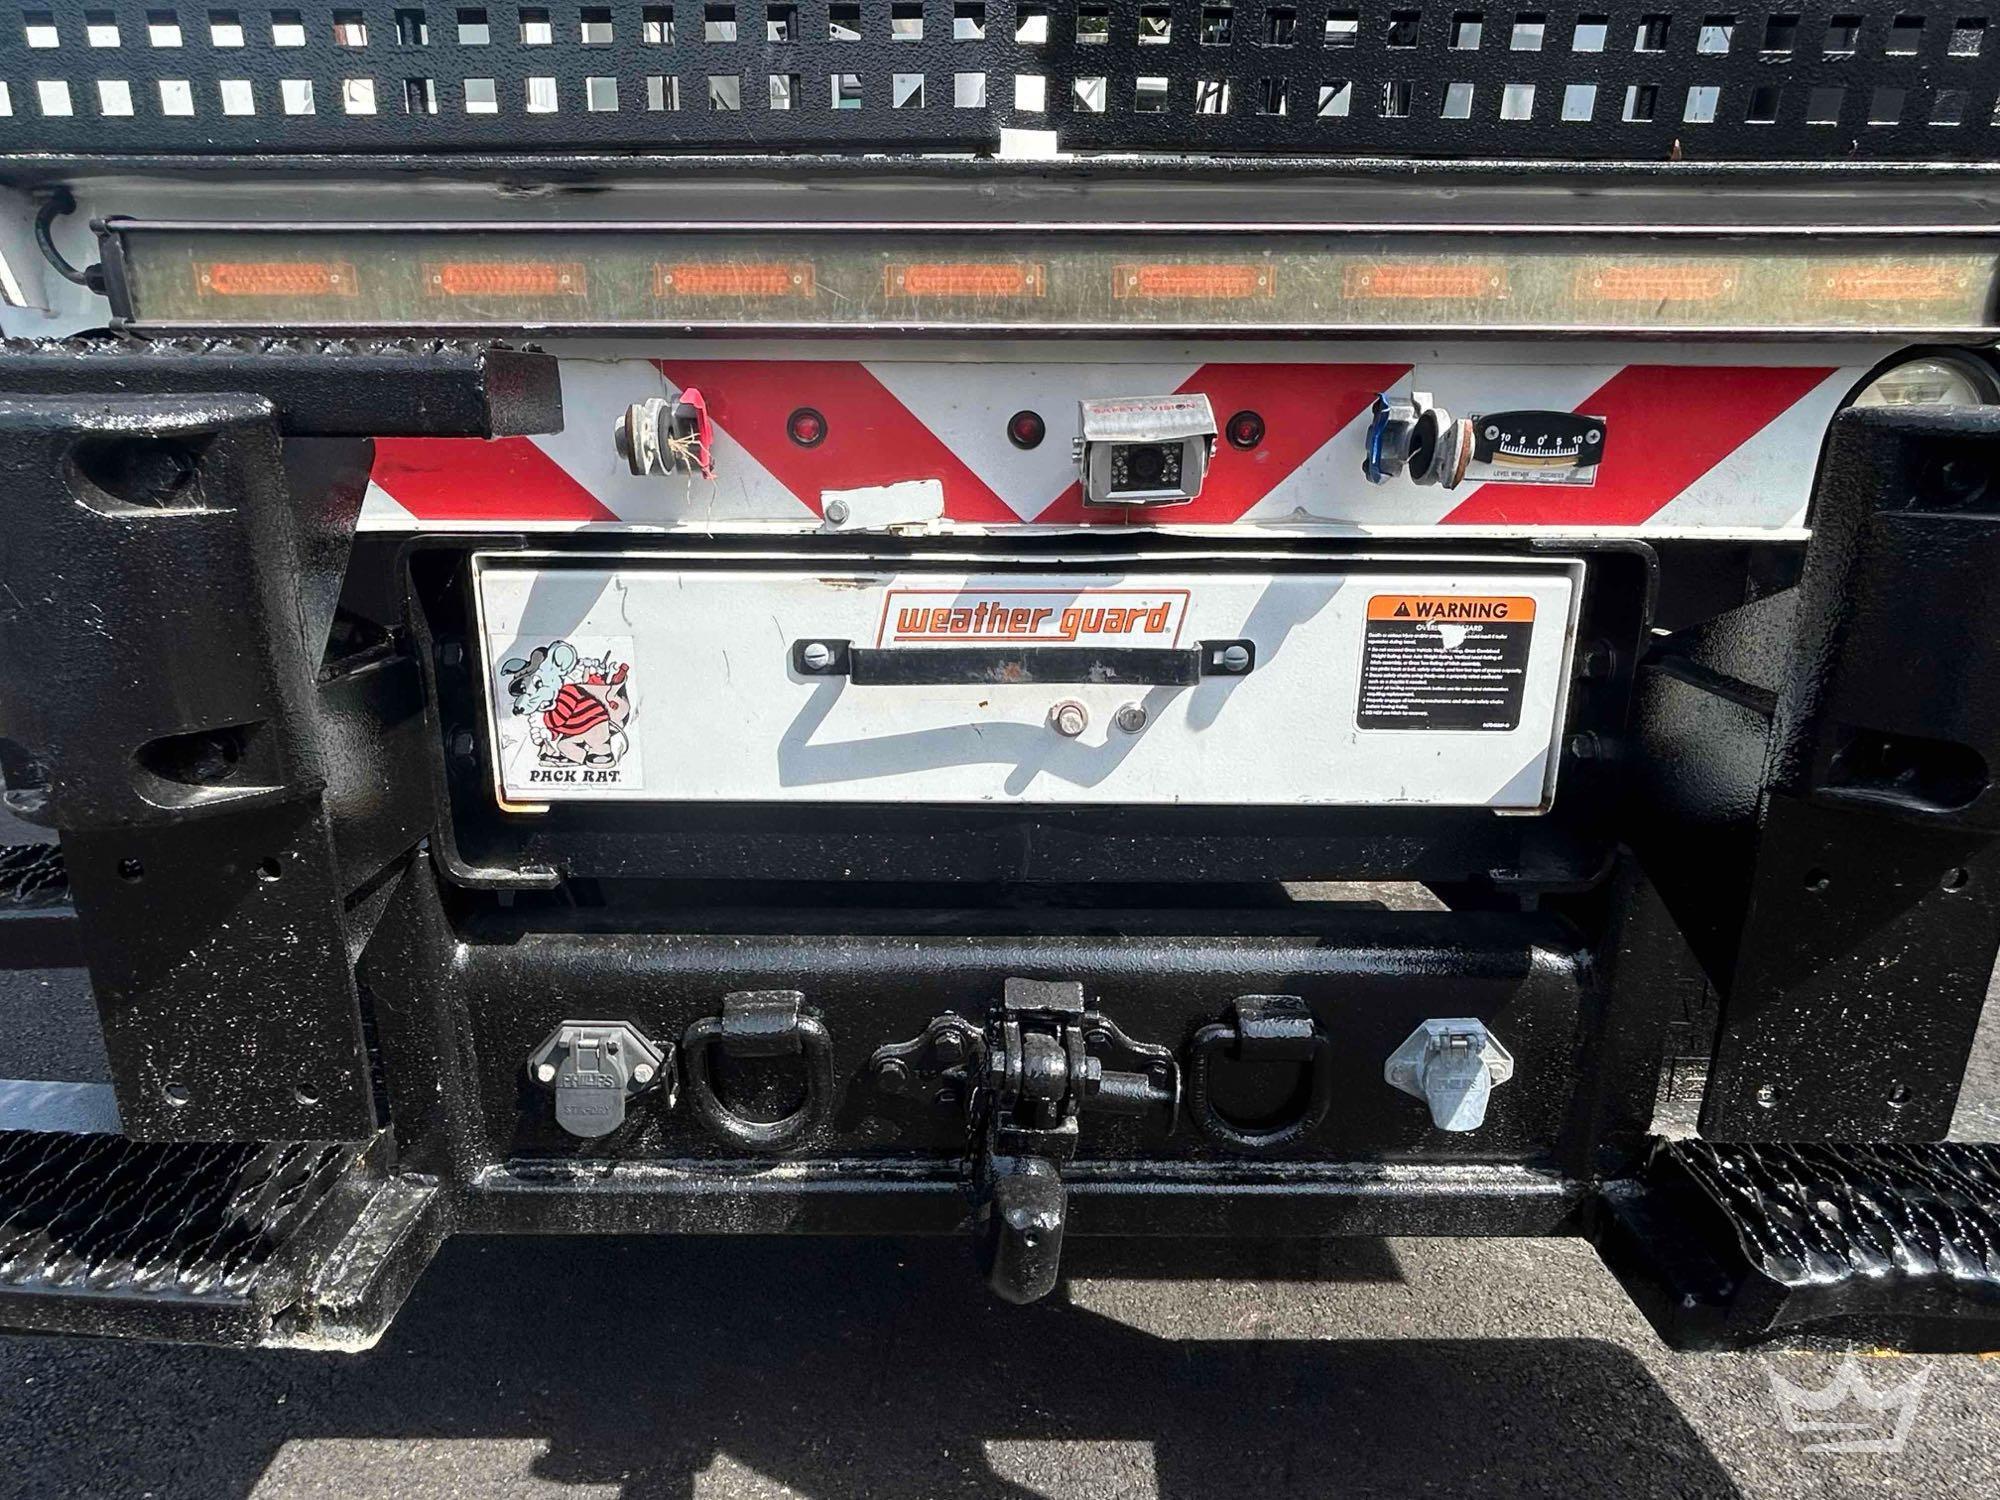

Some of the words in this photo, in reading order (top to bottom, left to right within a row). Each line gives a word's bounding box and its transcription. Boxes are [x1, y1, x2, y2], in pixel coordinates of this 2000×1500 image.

[1150, 402, 1196, 411] VISION
[1500, 433, 1511, 442] 10
[1520, 436, 1526, 444] 5
[1556, 437, 1562, 445] 5
[1572, 435, 1583, 444] 10
[1416, 602, 1508, 618] WARNING
[896, 602, 1052, 633] weather
[1059, 602, 1171, 641] guard
[530, 770, 577, 782] PACK
